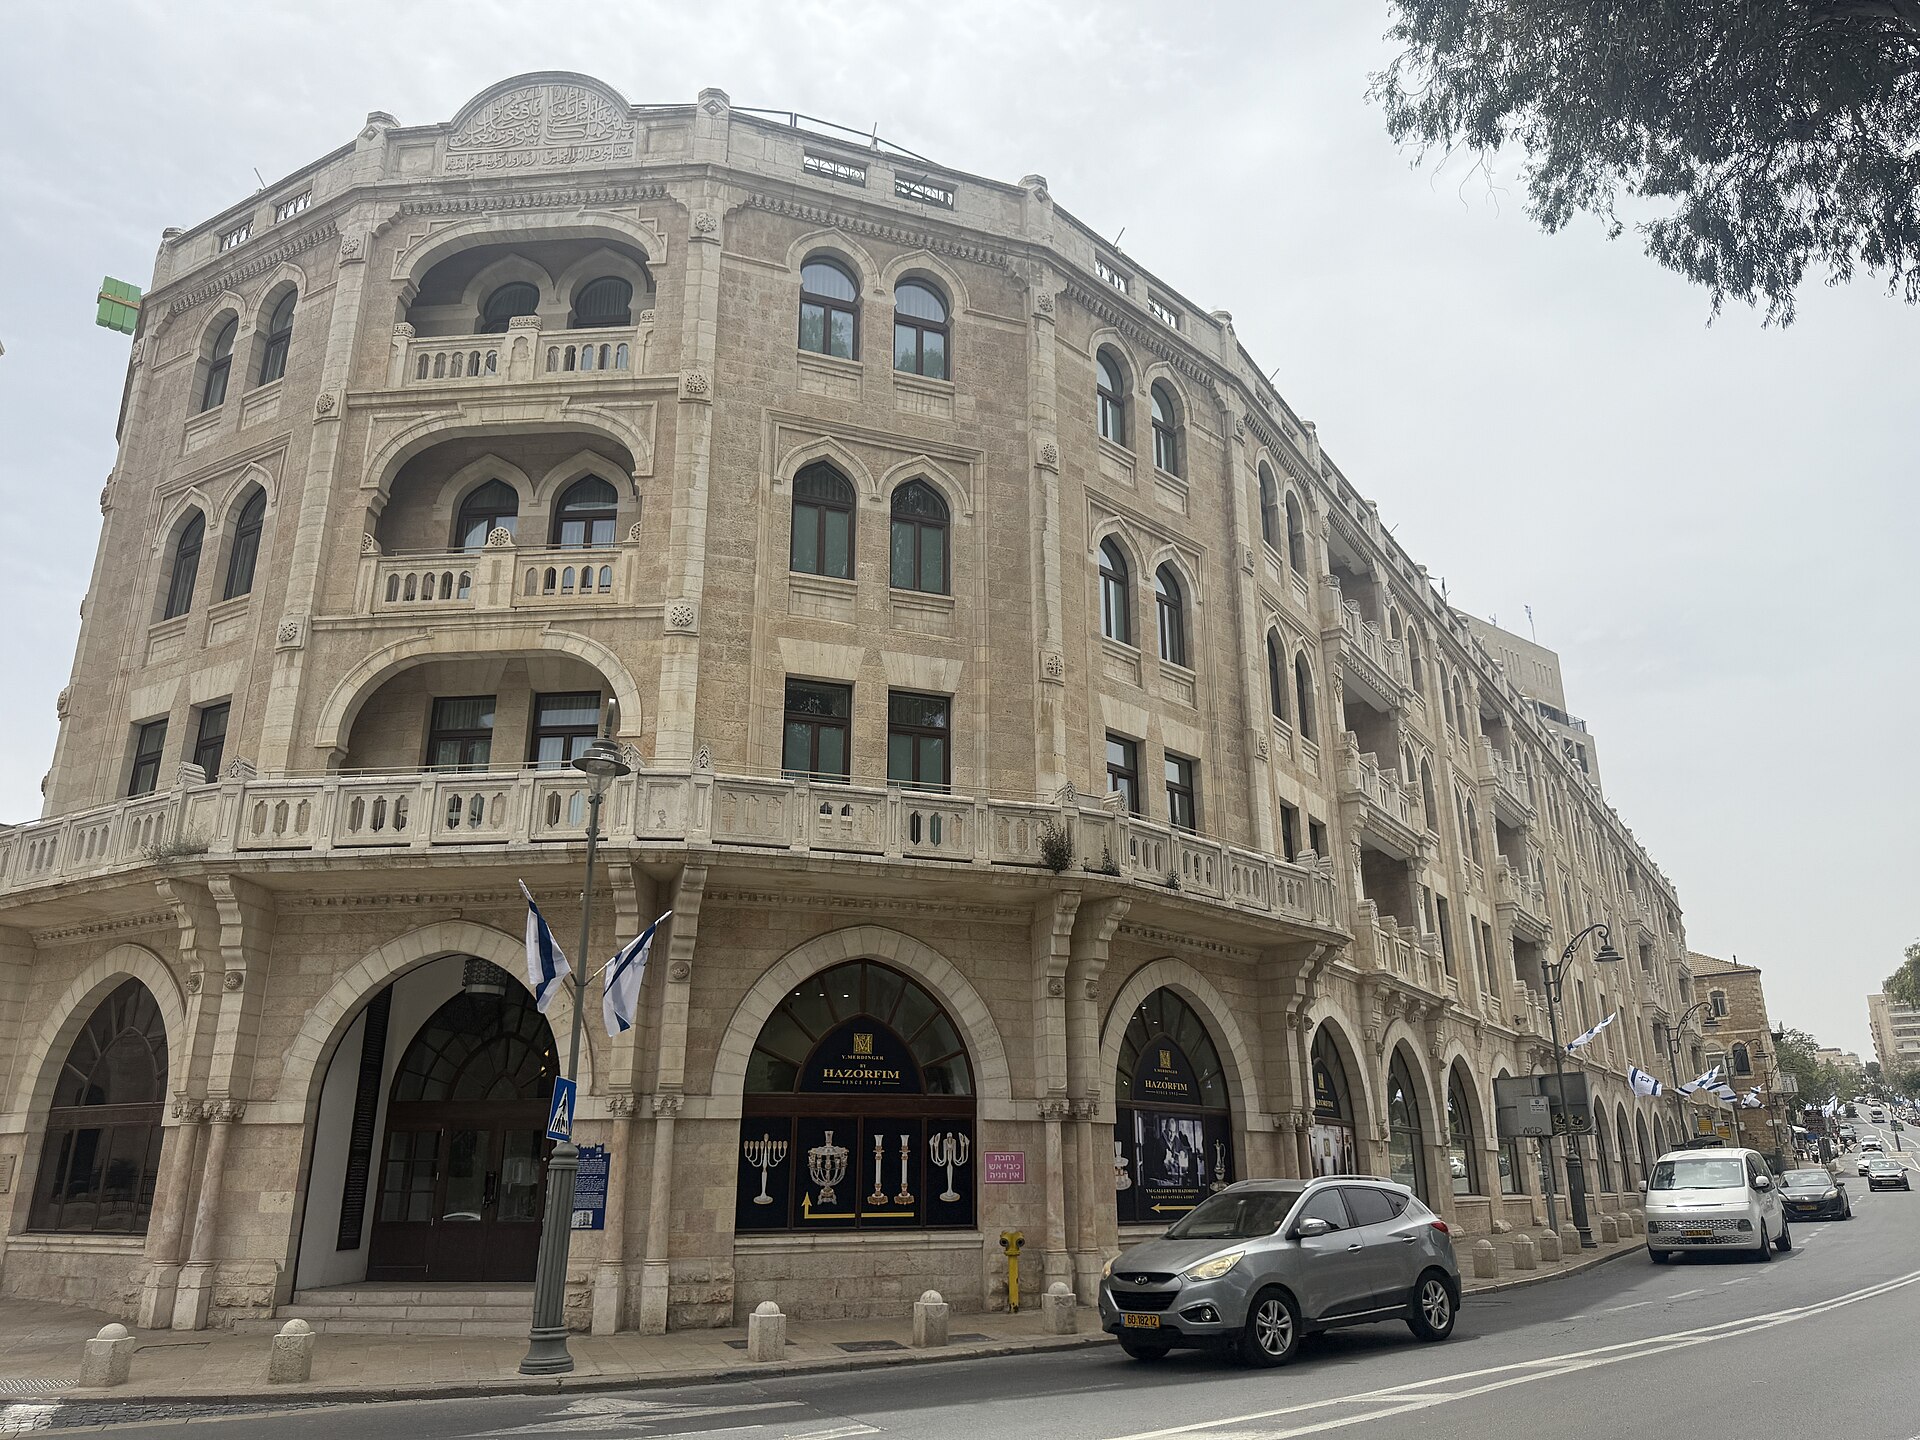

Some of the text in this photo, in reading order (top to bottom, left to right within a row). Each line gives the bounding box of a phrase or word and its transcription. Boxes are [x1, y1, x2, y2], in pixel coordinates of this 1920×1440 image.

[823, 1068, 900, 1079] HAZORFIM
[1145, 1080, 1188, 1091] HAZORFIM
[989, 1171, 1020, 1180] אין חניה
